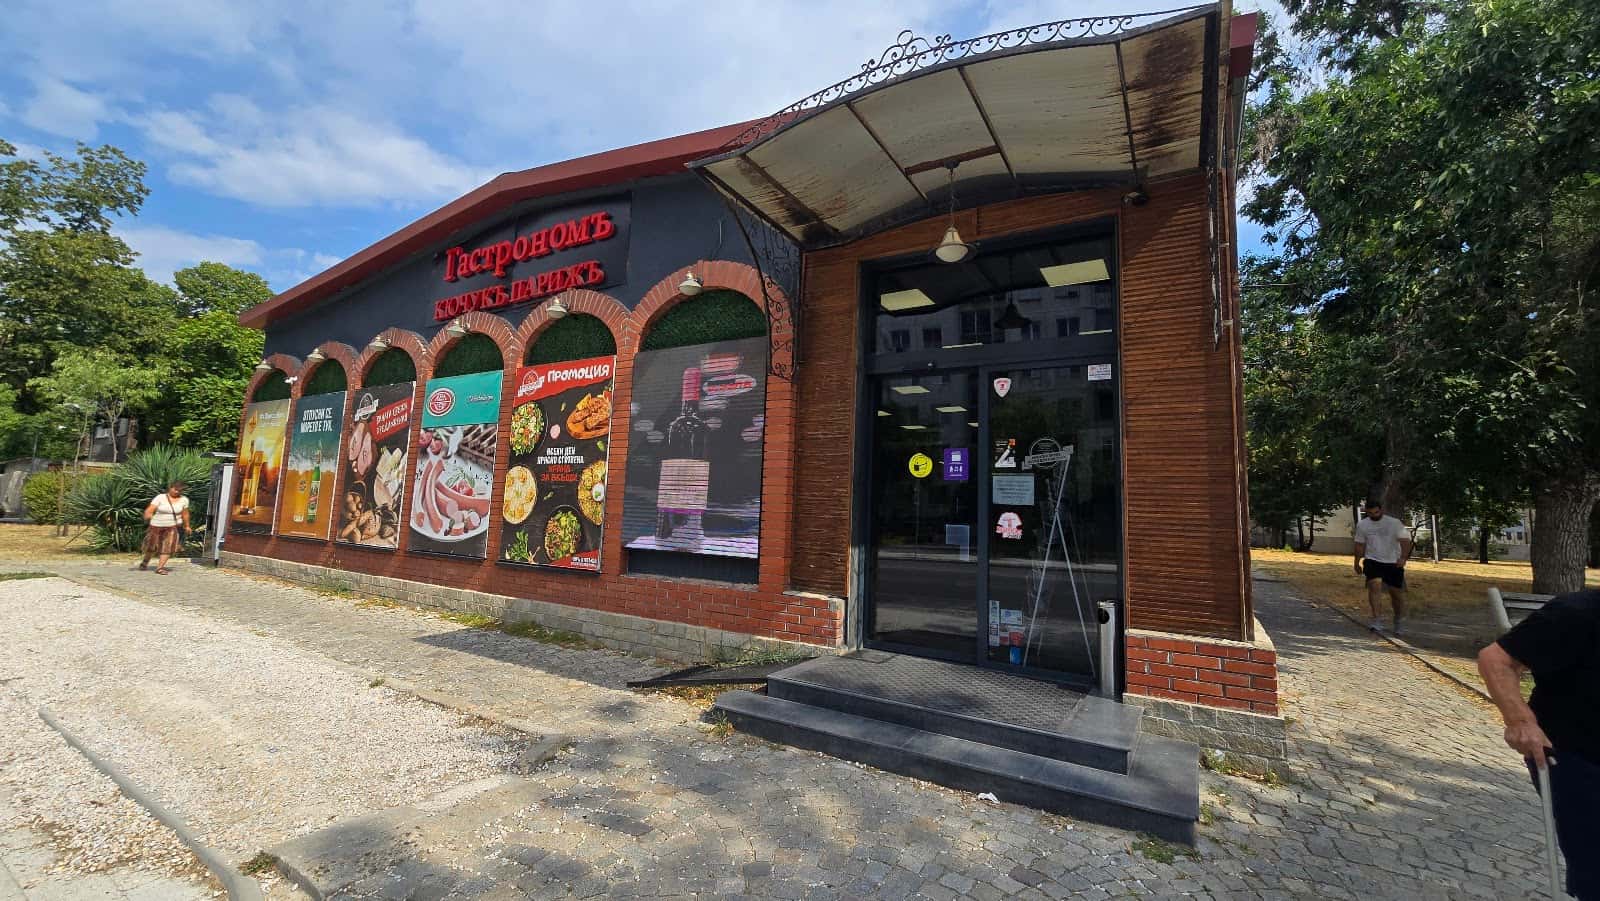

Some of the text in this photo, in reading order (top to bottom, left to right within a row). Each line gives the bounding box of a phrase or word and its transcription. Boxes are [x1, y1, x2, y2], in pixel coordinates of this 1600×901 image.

[433, 260, 605, 320] КЮЧУКЪ ПАРИЖЪ
[547, 364, 610, 383] ПРОМОЦИЯ
